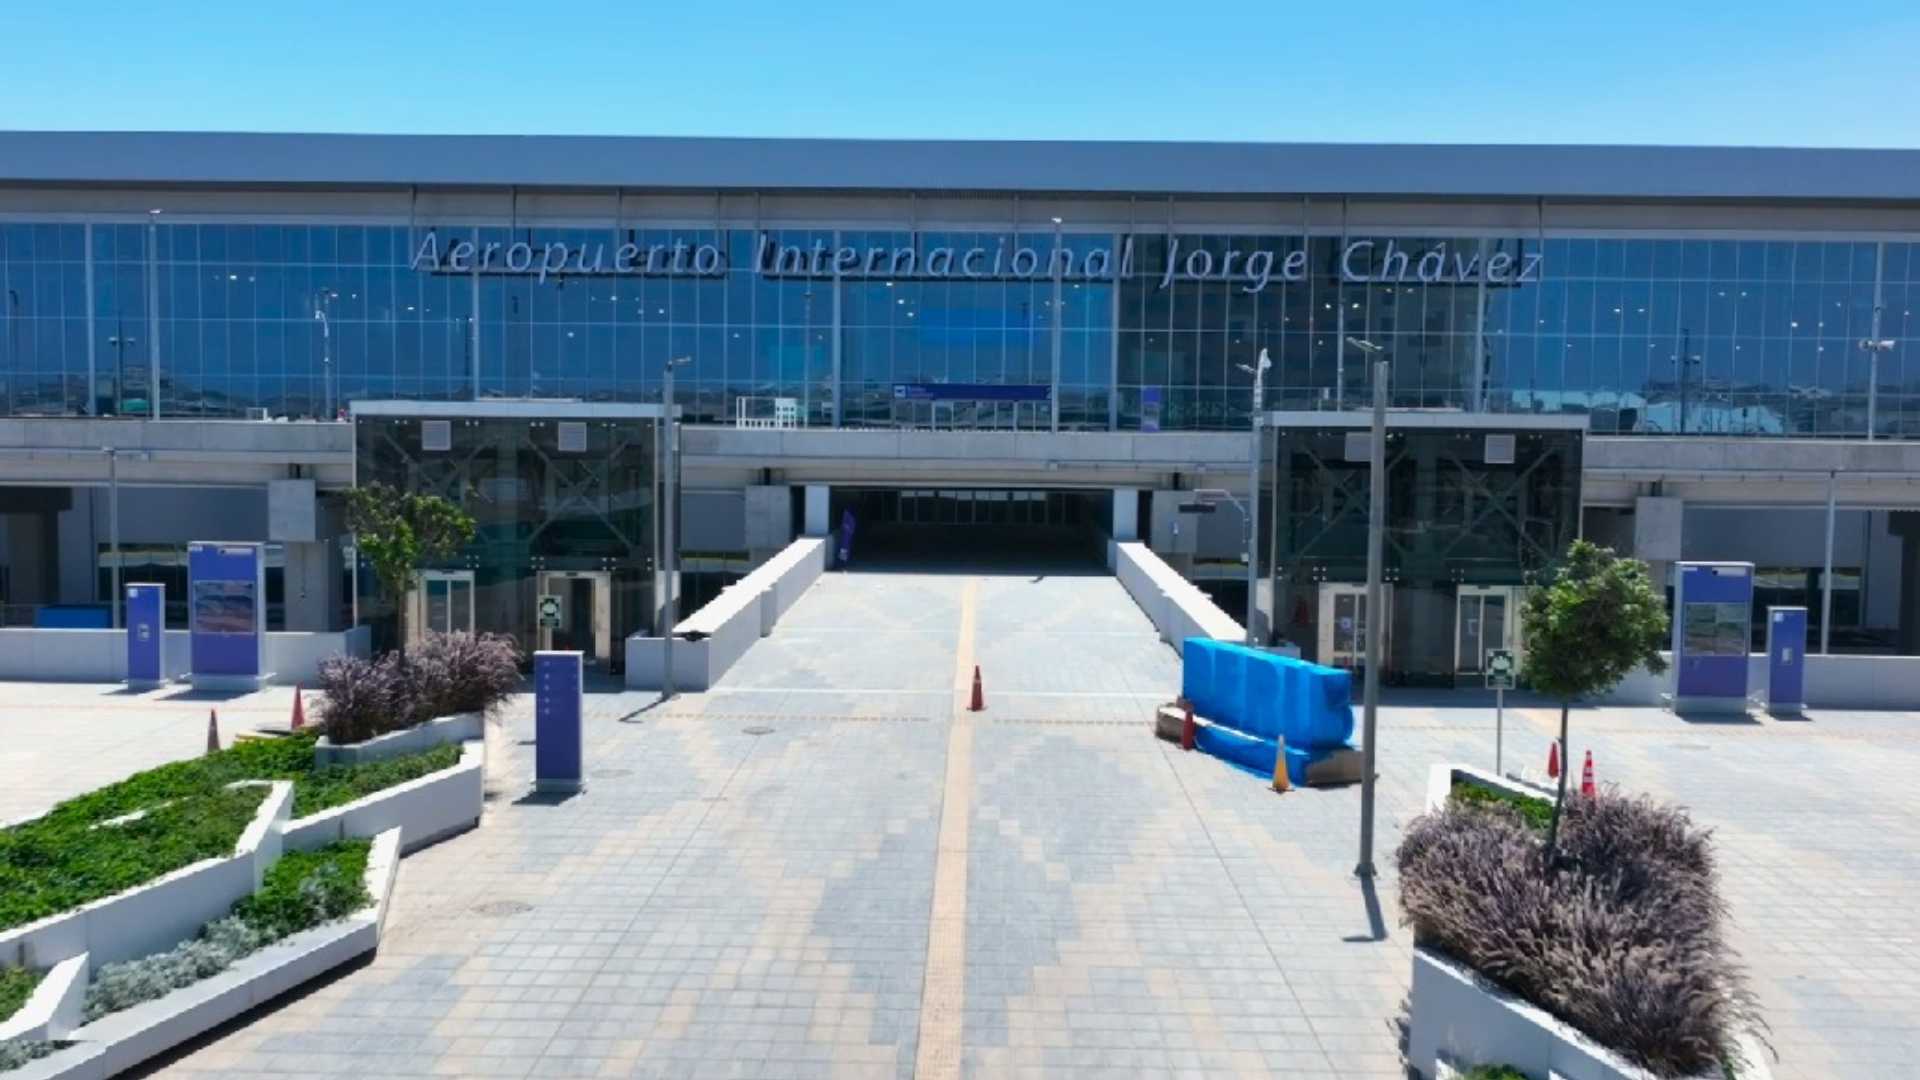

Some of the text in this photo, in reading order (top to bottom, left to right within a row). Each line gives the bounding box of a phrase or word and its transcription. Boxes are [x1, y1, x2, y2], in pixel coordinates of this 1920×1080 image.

[410, 231, 1544, 293] Aeropuerto Internacional Jorge Chávez
